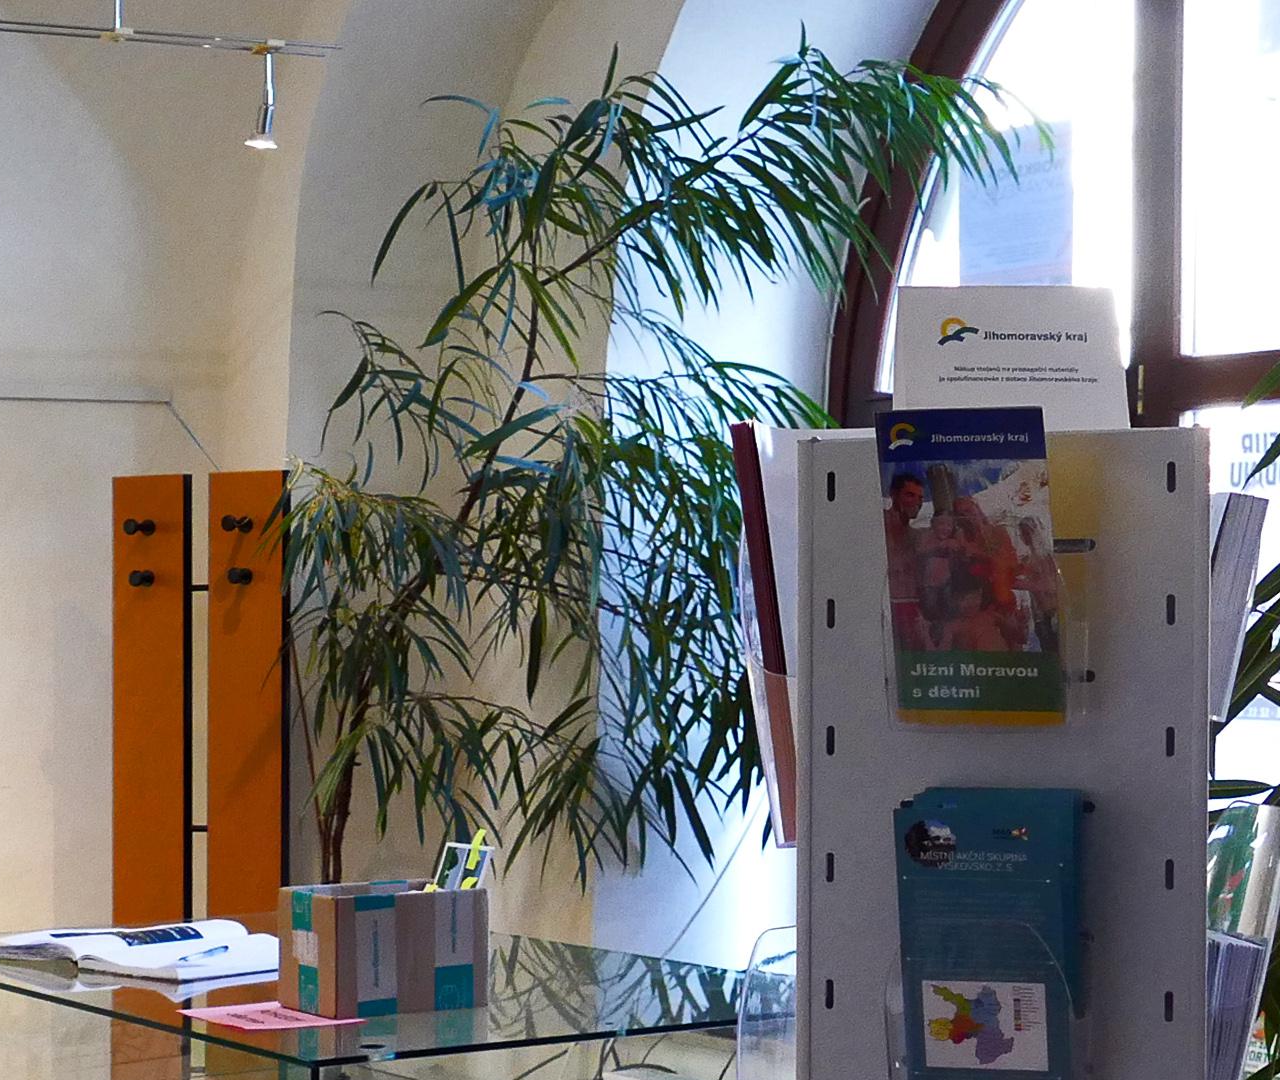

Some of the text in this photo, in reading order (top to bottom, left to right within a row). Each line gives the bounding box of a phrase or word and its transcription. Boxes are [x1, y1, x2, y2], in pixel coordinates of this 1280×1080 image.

[983, 331, 1088, 343] Jihomoravský kraj
[931, 432, 1029, 444] Jihomoravský kraj
[910, 663, 1038, 677] Jižní Moravou
[912, 685, 980, 698] s dětmi
